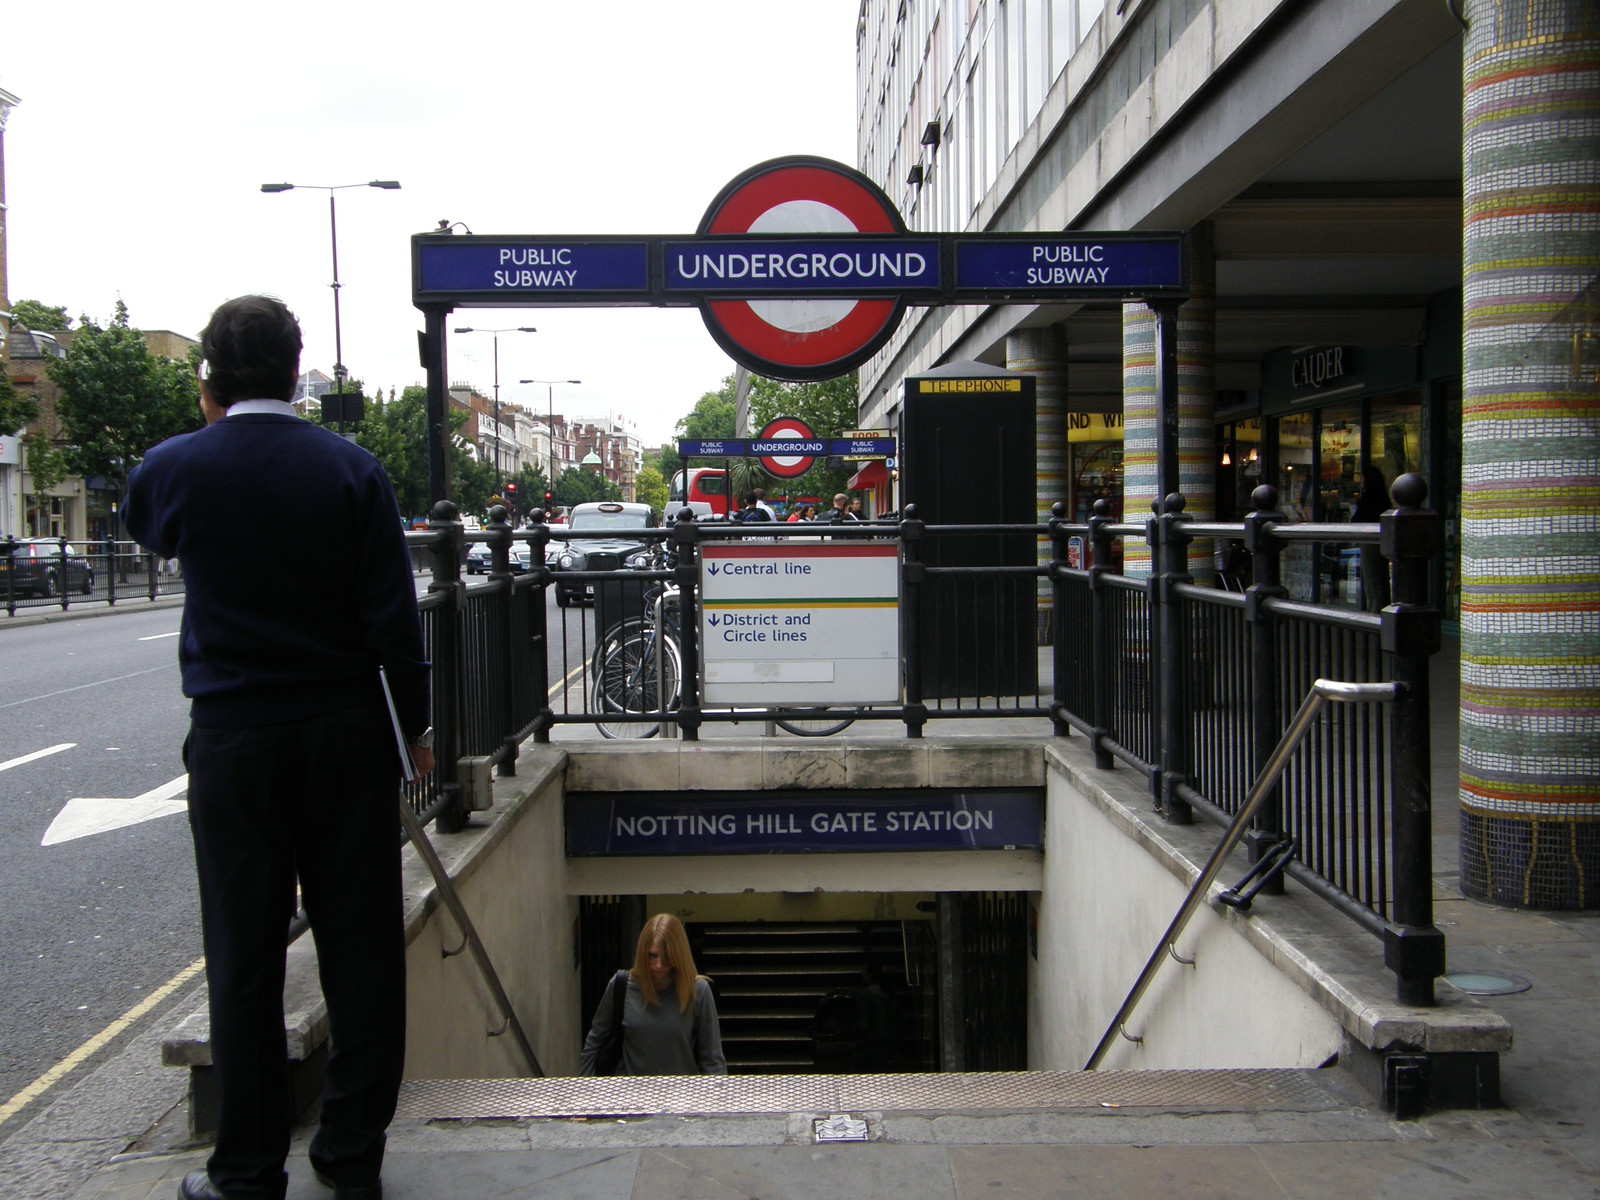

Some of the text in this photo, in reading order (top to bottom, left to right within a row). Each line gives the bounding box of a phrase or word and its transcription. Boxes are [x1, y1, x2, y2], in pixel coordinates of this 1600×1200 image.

[499, 248, 572, 266] PUBLIC
[1032, 246, 1104, 263] PUBLIC
[678, 252, 926, 279] UNDERGROUND
[493, 270, 578, 287] SUBWAY
[1026, 267, 1110, 284] SUBWAY
[1292, 347, 1344, 388] CALDER
[928, 379, 1012, 392] TELEPHONE
[1068, 413, 1089, 429] ND
[752, 443, 823, 452] UNDERGROUND
[722, 562, 812, 576] Central line
[722, 613, 811, 626] District and
[723, 629, 808, 643] Circle lines
[616, 809, 994, 837] NOTTING HILL GATE STATION
